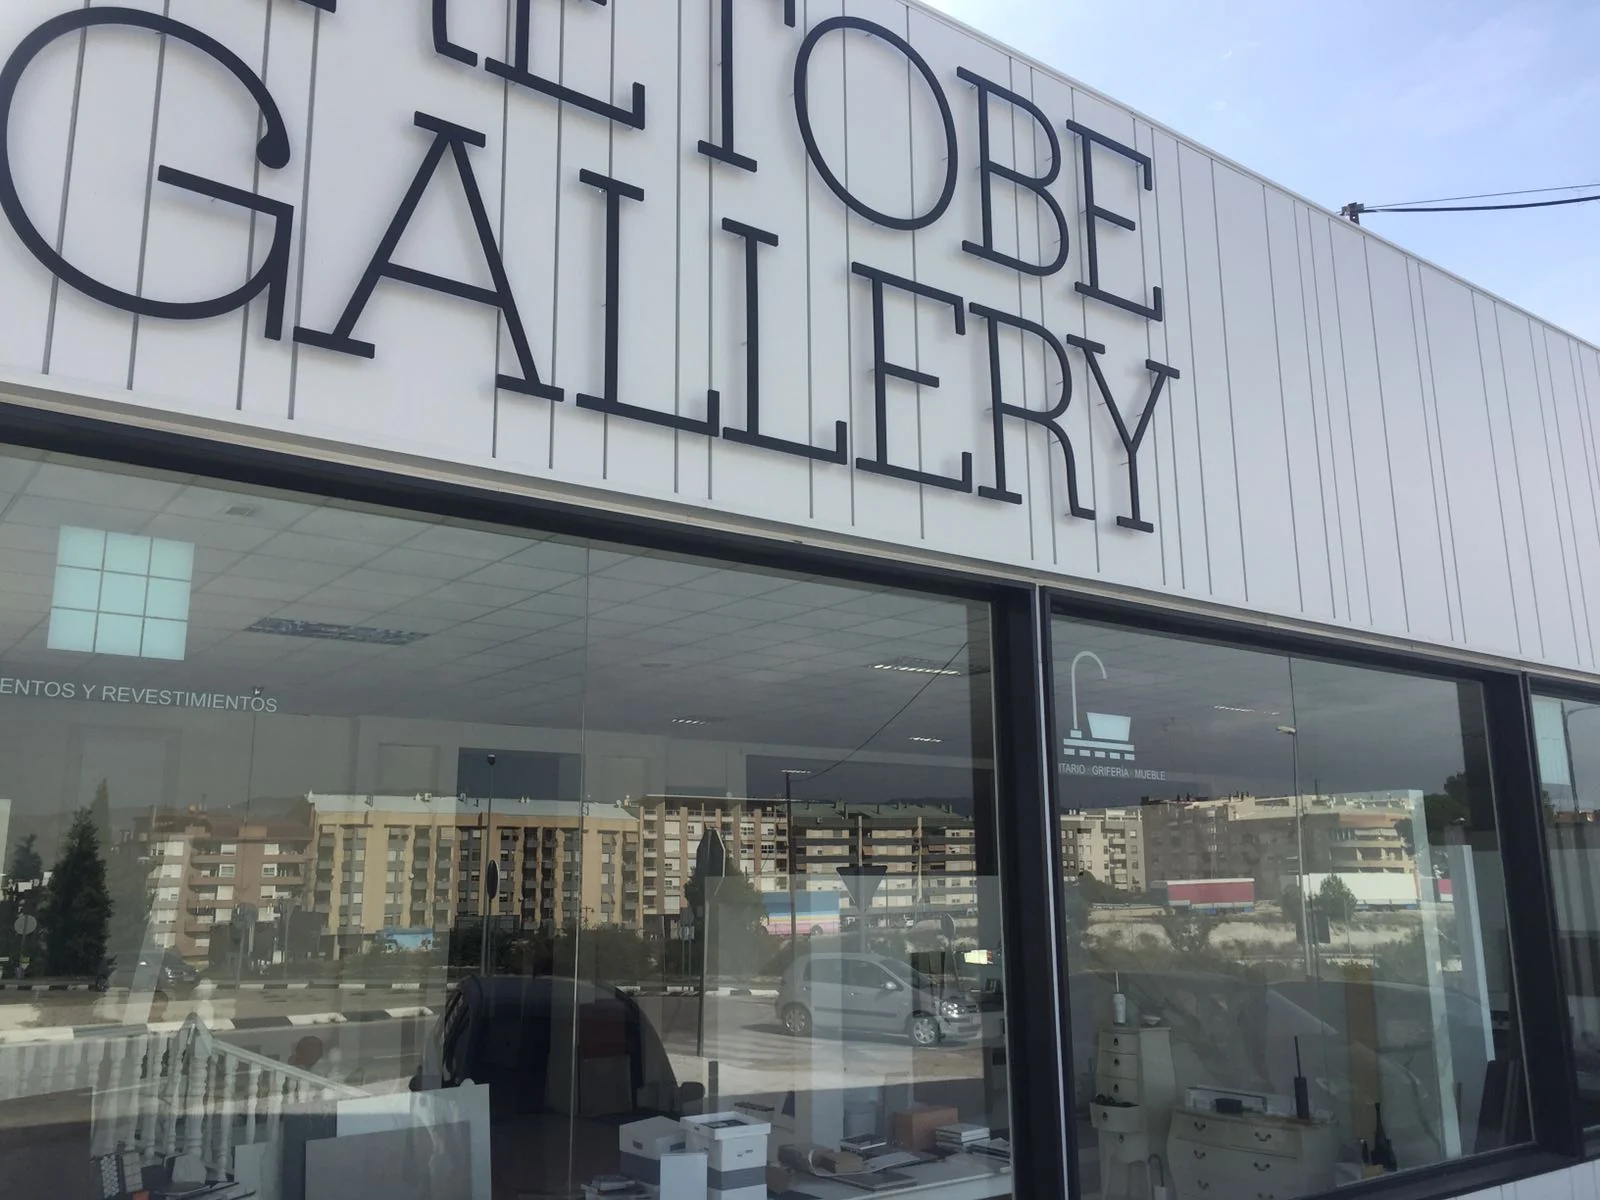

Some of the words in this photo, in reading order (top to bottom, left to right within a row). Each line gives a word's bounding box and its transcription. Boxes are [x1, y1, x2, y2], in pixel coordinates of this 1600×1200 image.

[0, 6, 1180, 533] GALLERY
[82, 684, 97, 699] Y
[102, 685, 278, 713] REVESTIMIENTOS
[1134, 769, 1166, 781] MUEBLE
